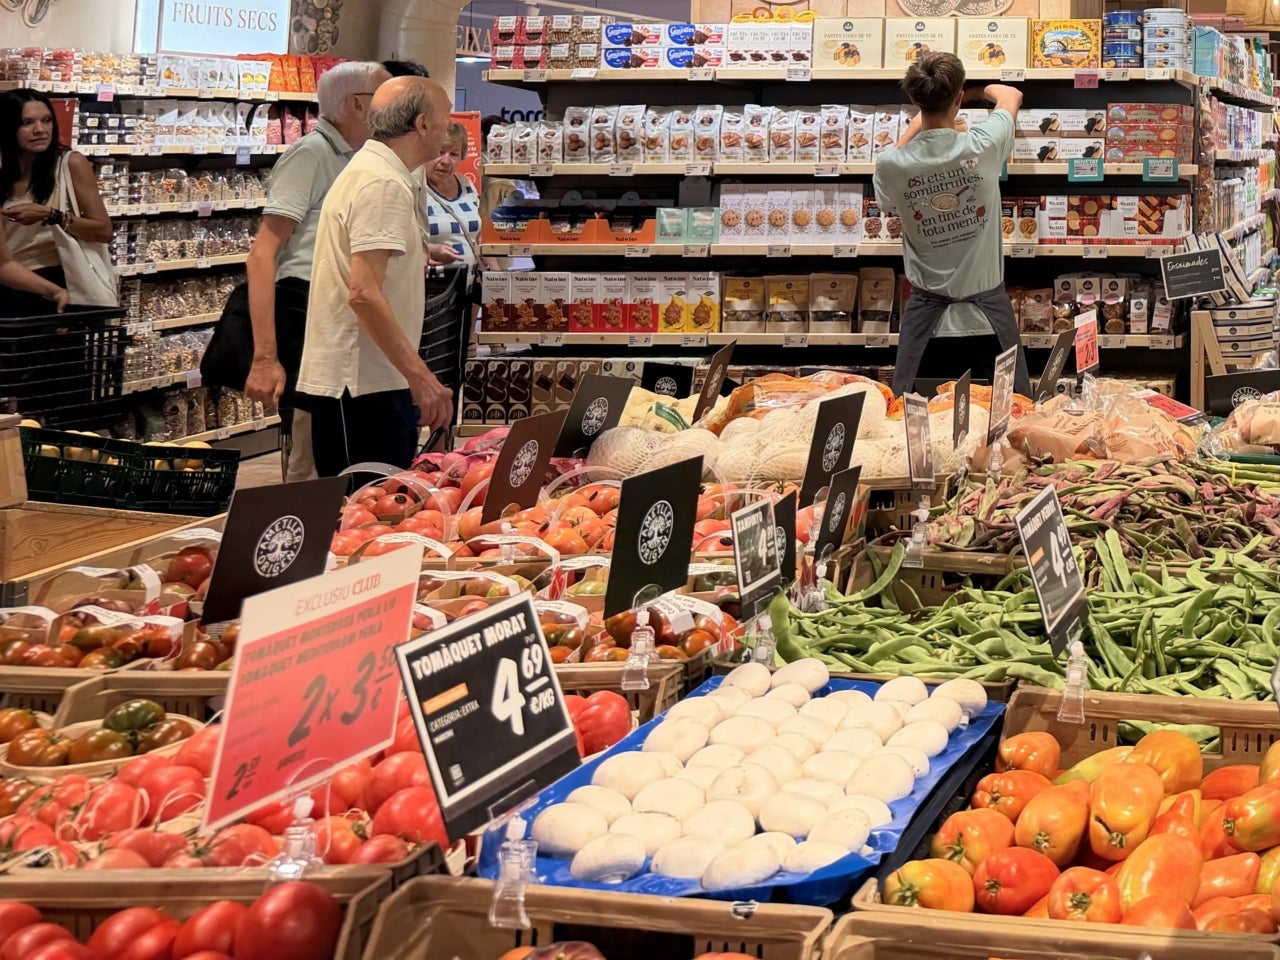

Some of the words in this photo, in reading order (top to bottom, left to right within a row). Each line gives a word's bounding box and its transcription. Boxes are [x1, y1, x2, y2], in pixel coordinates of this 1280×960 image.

[173, 1, 234, 28] FRUITS
[238, 9, 278, 32] SECS
[914, 174, 926, 187] Si
[927, 172, 946, 183] ets
[947, 167, 965, 179] un
[921, 215, 937, 227] en
[939, 209, 960, 222] tinc
[962, 204, 976, 216] de
[922, 224, 946, 238] tota
[947, 215, 980, 232] mena
[1167, 255, 1209, 272] Ensaimades
[259, 518, 303, 550] AMETLLER
[641, 502, 673, 538] AMETLLER
[257, 550, 296, 574] ORIGEN
[640, 534, 668, 563] ORIGEN
[758, 528, 768, 566] 4
[1050, 531, 1067, 589] 4
[295, 585, 350, 617] EXCLUSIU
[352, 573, 382, 596] CLUB
[356, 603, 382, 625] PERLA
[357, 621, 385, 641] PERLA
[411, 631, 484, 681] TOMÀQUET
[481, 612, 528, 649] MORAT
[521, 643, 544, 680] 69
[287, 673, 328, 748] 2
[340, 650, 376, 726] 3
[491, 656, 526, 737] 4
[529, 687, 556, 715] €/KG
[226, 762, 249, 801] 2
